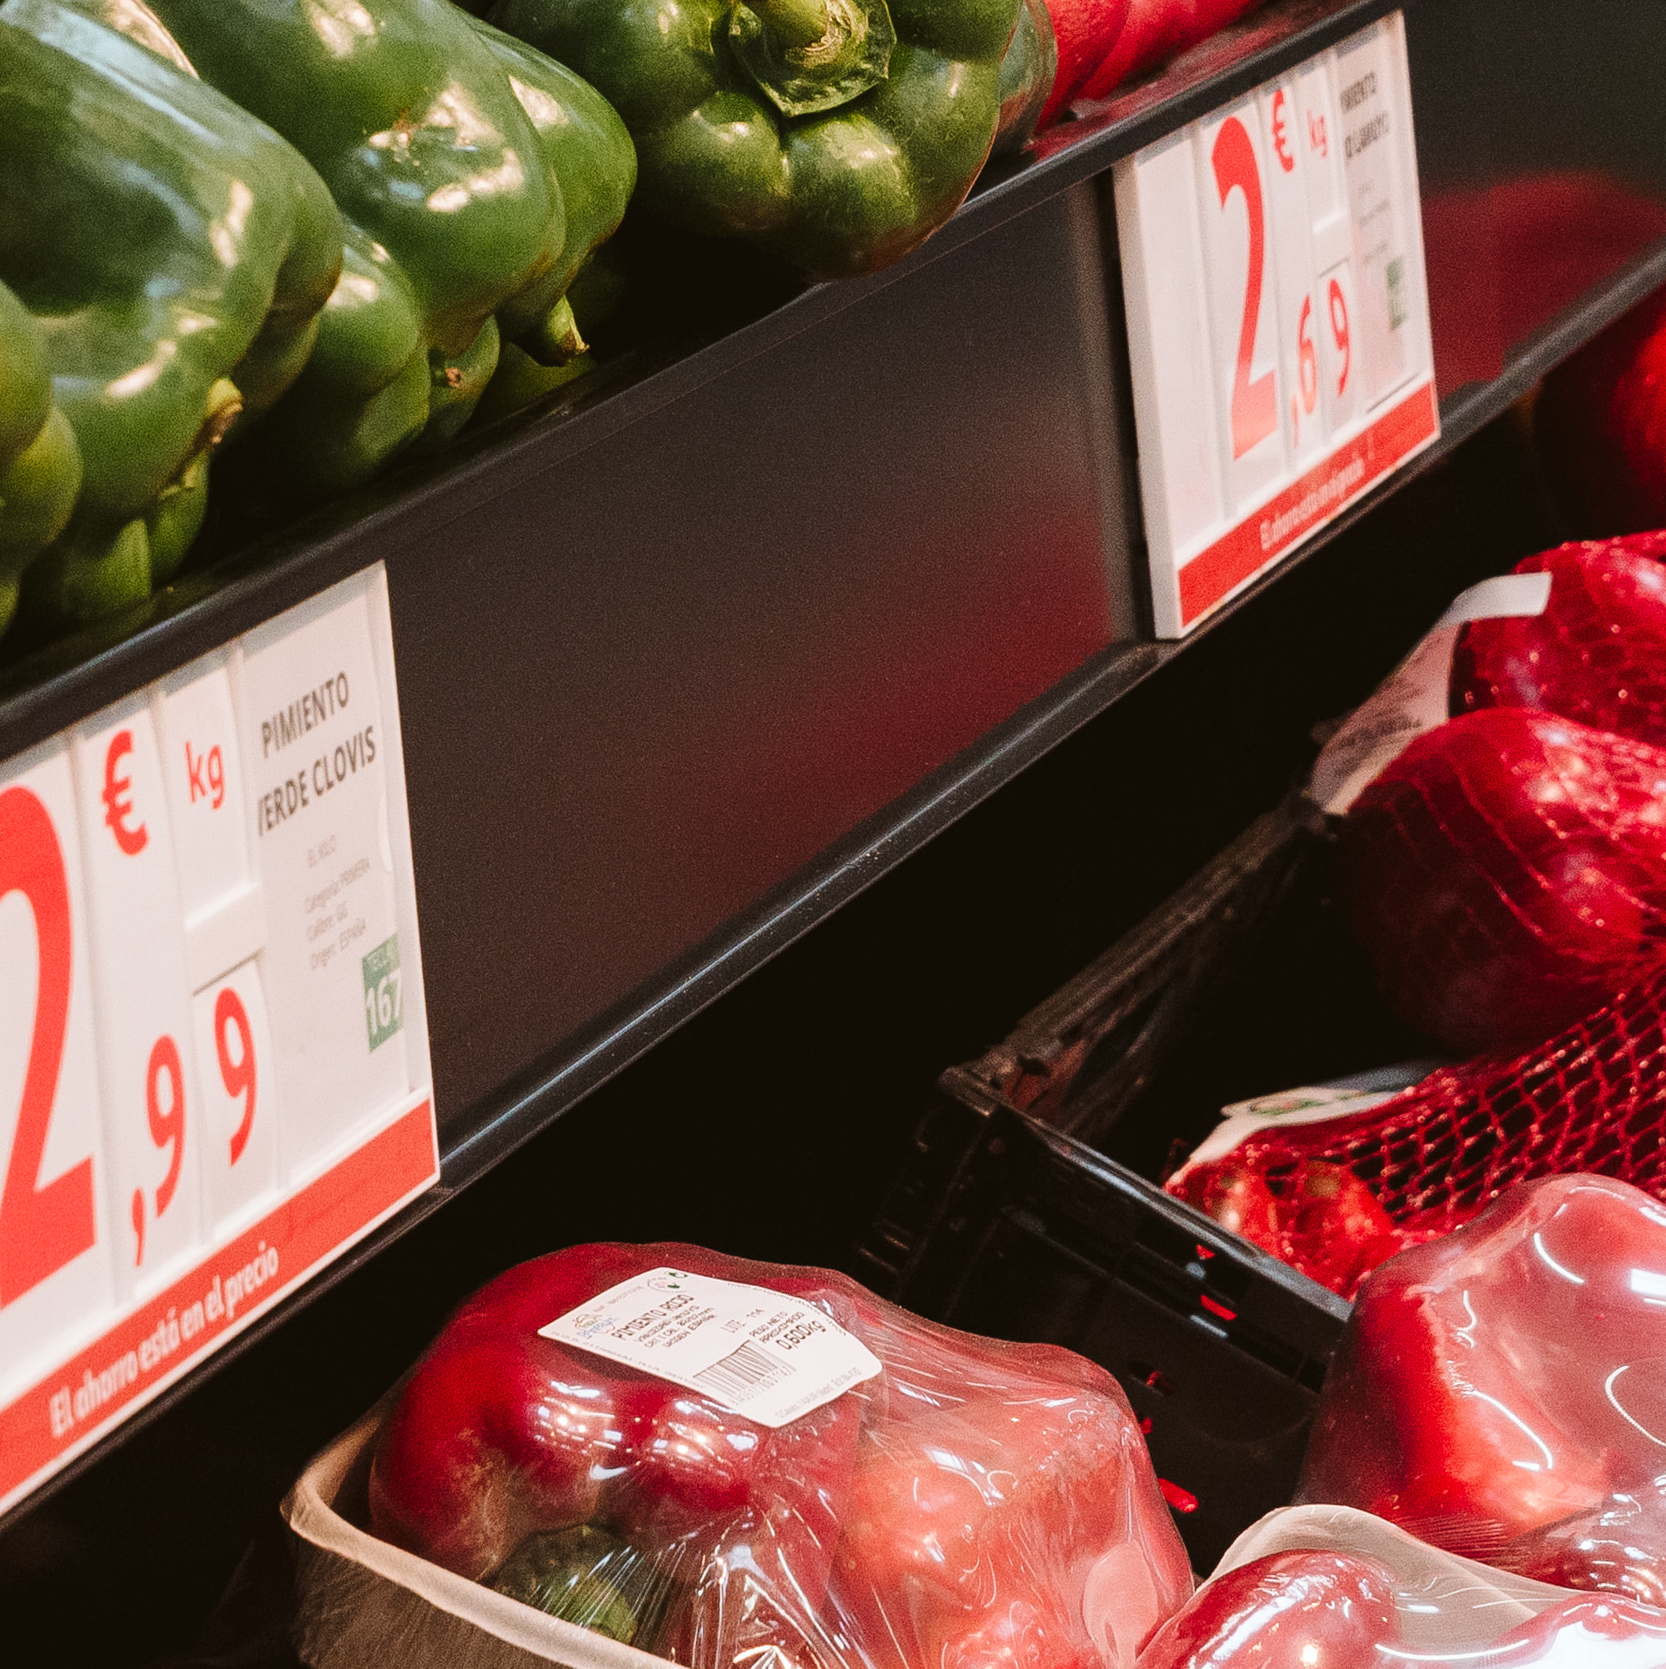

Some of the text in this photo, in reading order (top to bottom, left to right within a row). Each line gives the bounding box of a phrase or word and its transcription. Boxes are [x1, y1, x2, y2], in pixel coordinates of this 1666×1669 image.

[1211, 116, 1278, 461] 2
[1271, 88, 1295, 174] €
[261, 671, 350, 759] PIMIENTO
[102, 730, 149, 856] €
[185, 741, 225, 811] kg
[312, 725, 376, 797] CLOVIS
[366, 967, 401, 1035] 167
[49, 1240, 279, 1439] El ahorro está en el precio
[611, 1310, 667, 1340] PIMIENTO
